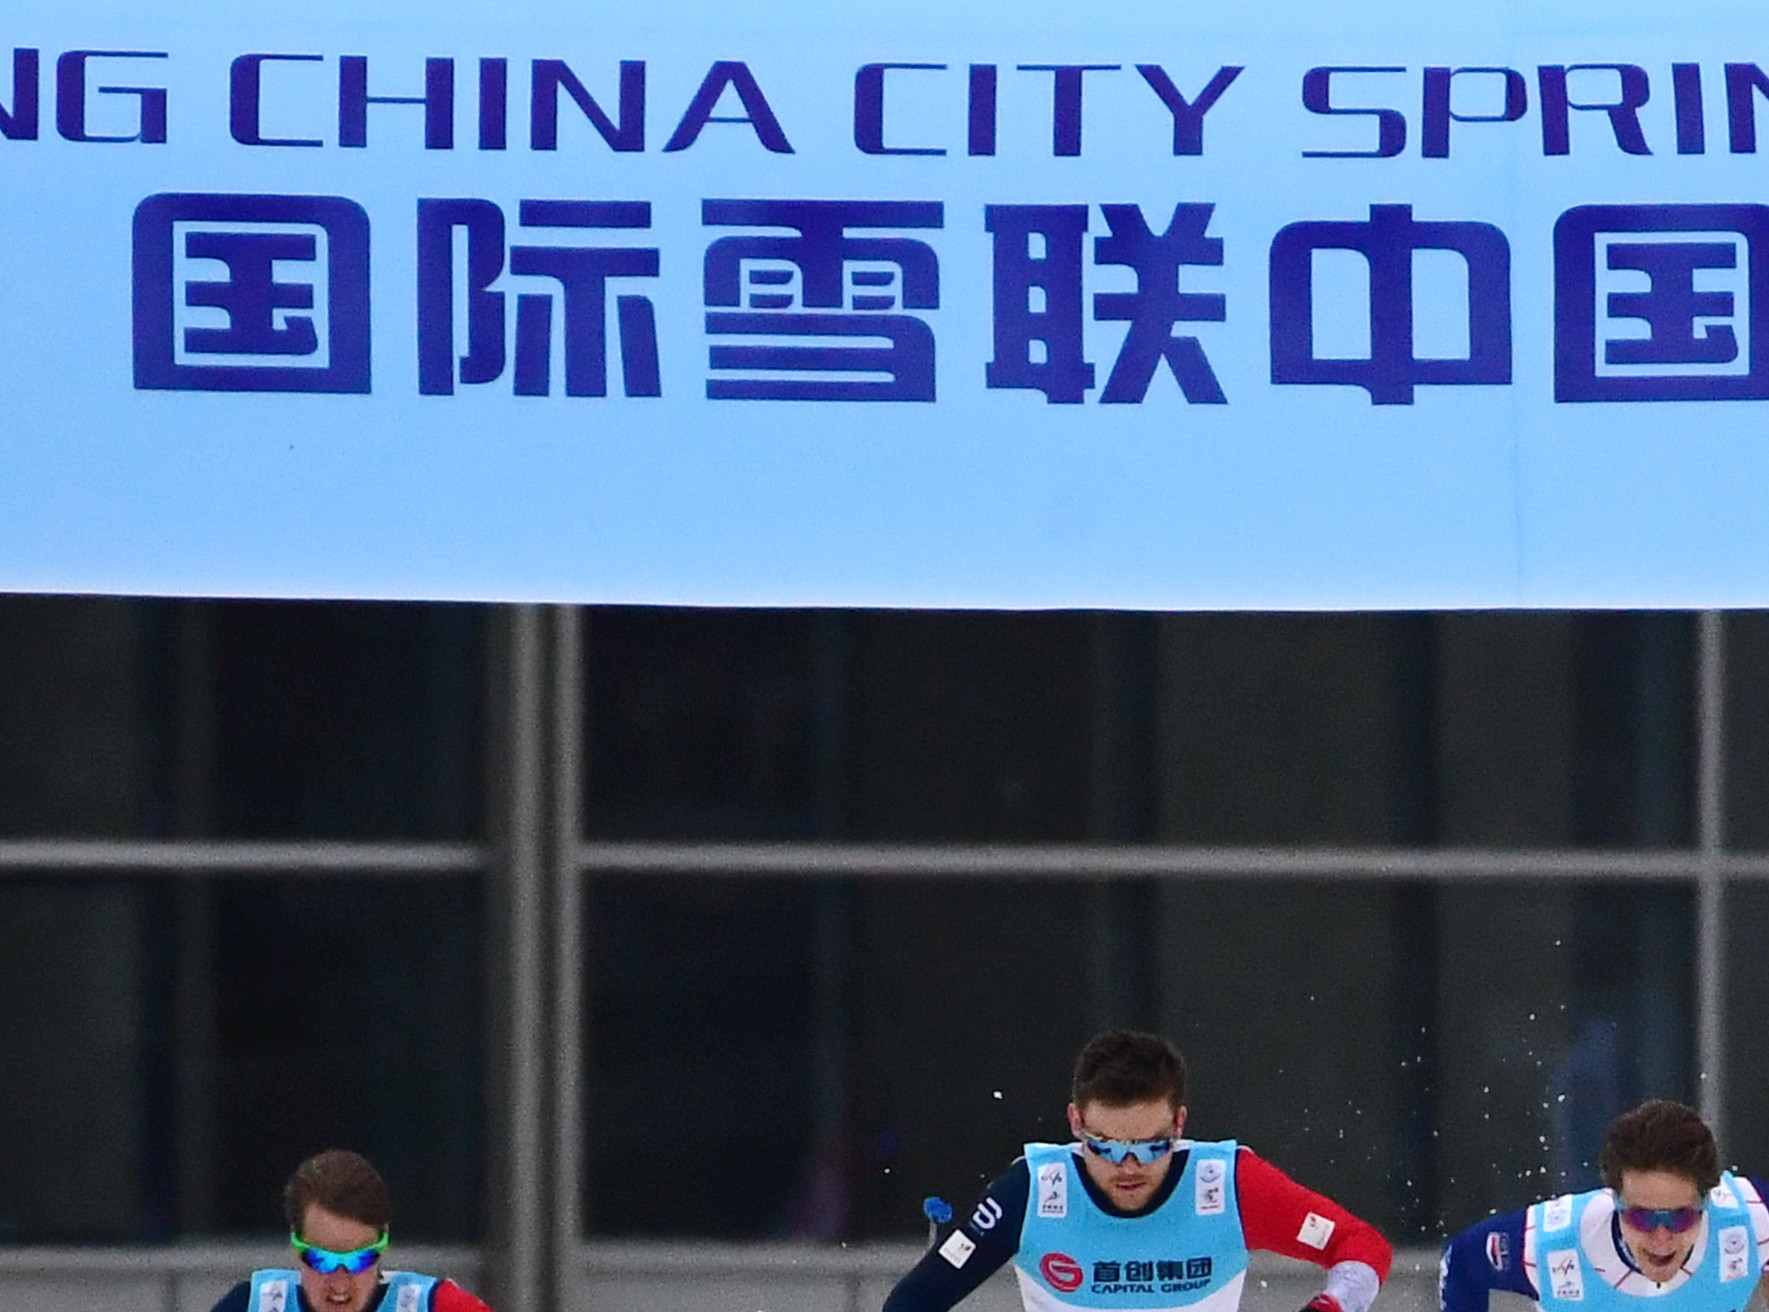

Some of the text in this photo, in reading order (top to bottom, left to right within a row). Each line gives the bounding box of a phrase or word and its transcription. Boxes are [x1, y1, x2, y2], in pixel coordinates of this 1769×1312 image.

[230, 55, 794, 155] CHINA
[855, 64, 1244, 157] CITY
[1092, 1278, 1211, 1294] CAPITAL GROUP
